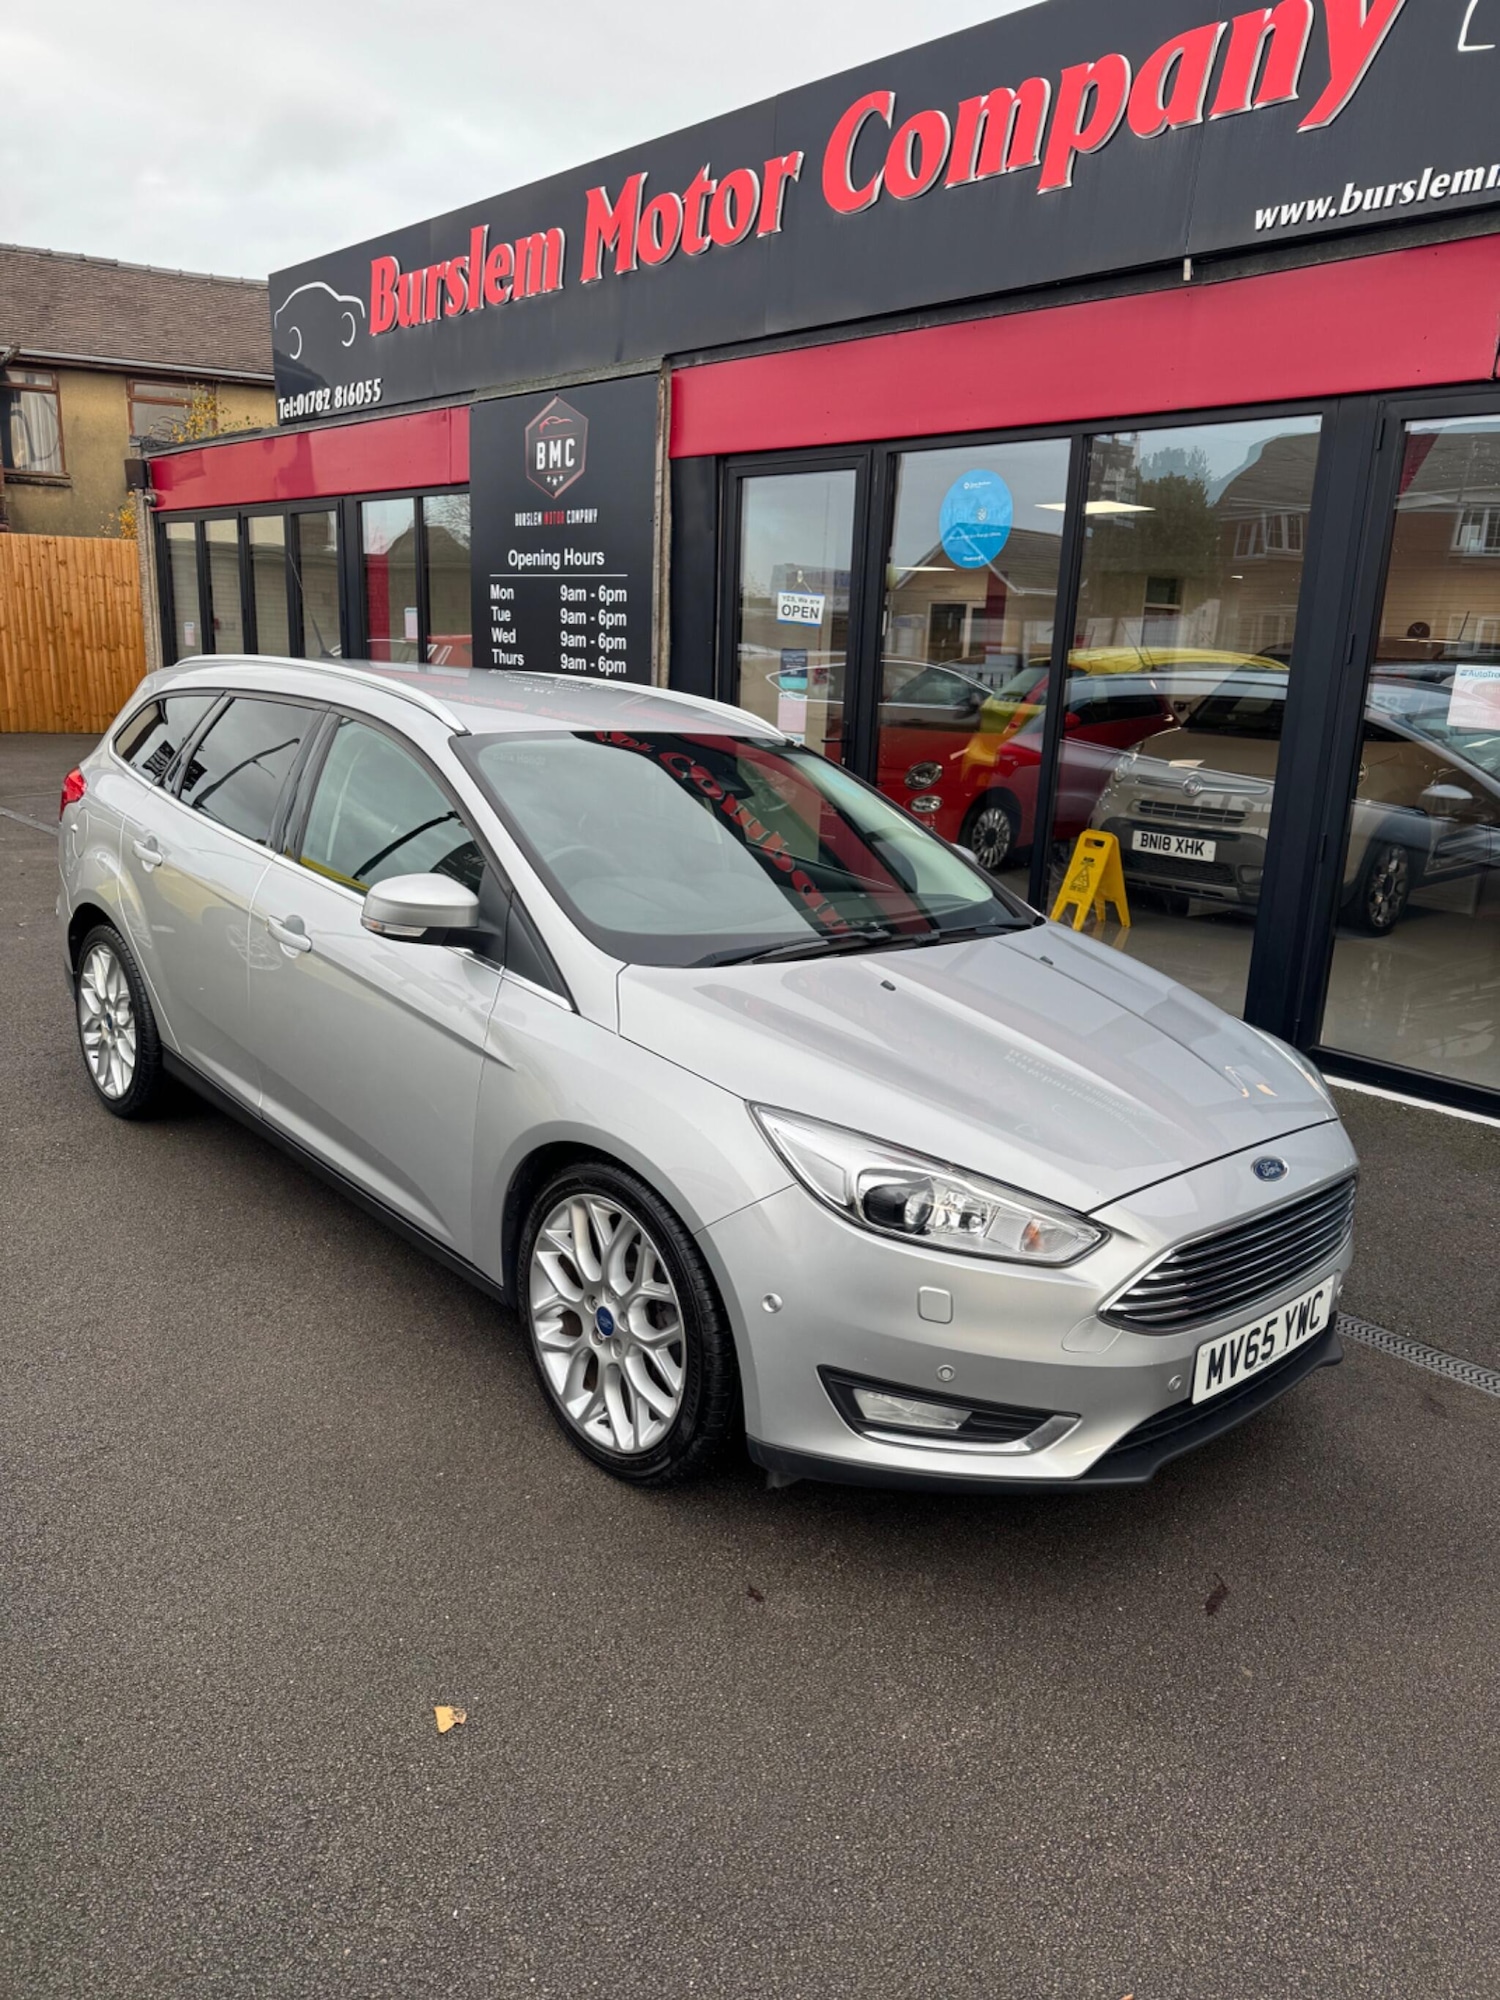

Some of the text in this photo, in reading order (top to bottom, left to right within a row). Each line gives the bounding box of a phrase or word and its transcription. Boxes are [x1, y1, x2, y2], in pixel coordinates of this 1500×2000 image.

[369, 0, 1404, 336] Burslem Motor Company
[278, 378, 382, 419] Tel:01782 816055
[536, 438, 575, 470] BMC
[515, 511, 542, 527] BURSLEM
[566, 508, 598, 524] COMPANY
[508, 548, 605, 571] Opening Hours
[490, 584, 515, 600] Mon
[560, 584, 587, 602] 9am
[598, 584, 627, 606] 6pm
[490, 606, 511, 622] Tue
[560, 608, 587, 625] 9am
[598, 609, 627, 630] 6pm
[781, 604, 820, 619] OPEN
[491, 627, 517, 644] Wed
[560, 630, 587, 648] 9am
[598, 632, 627, 653] 6pm
[491, 649, 525, 666] Thurs
[560, 653, 587, 671] 9am
[598, 655, 627, 677] 6pm
[1140, 833, 1206, 856] BN18 XHK
[1205, 1289, 1324, 1390] MV65 YWC
